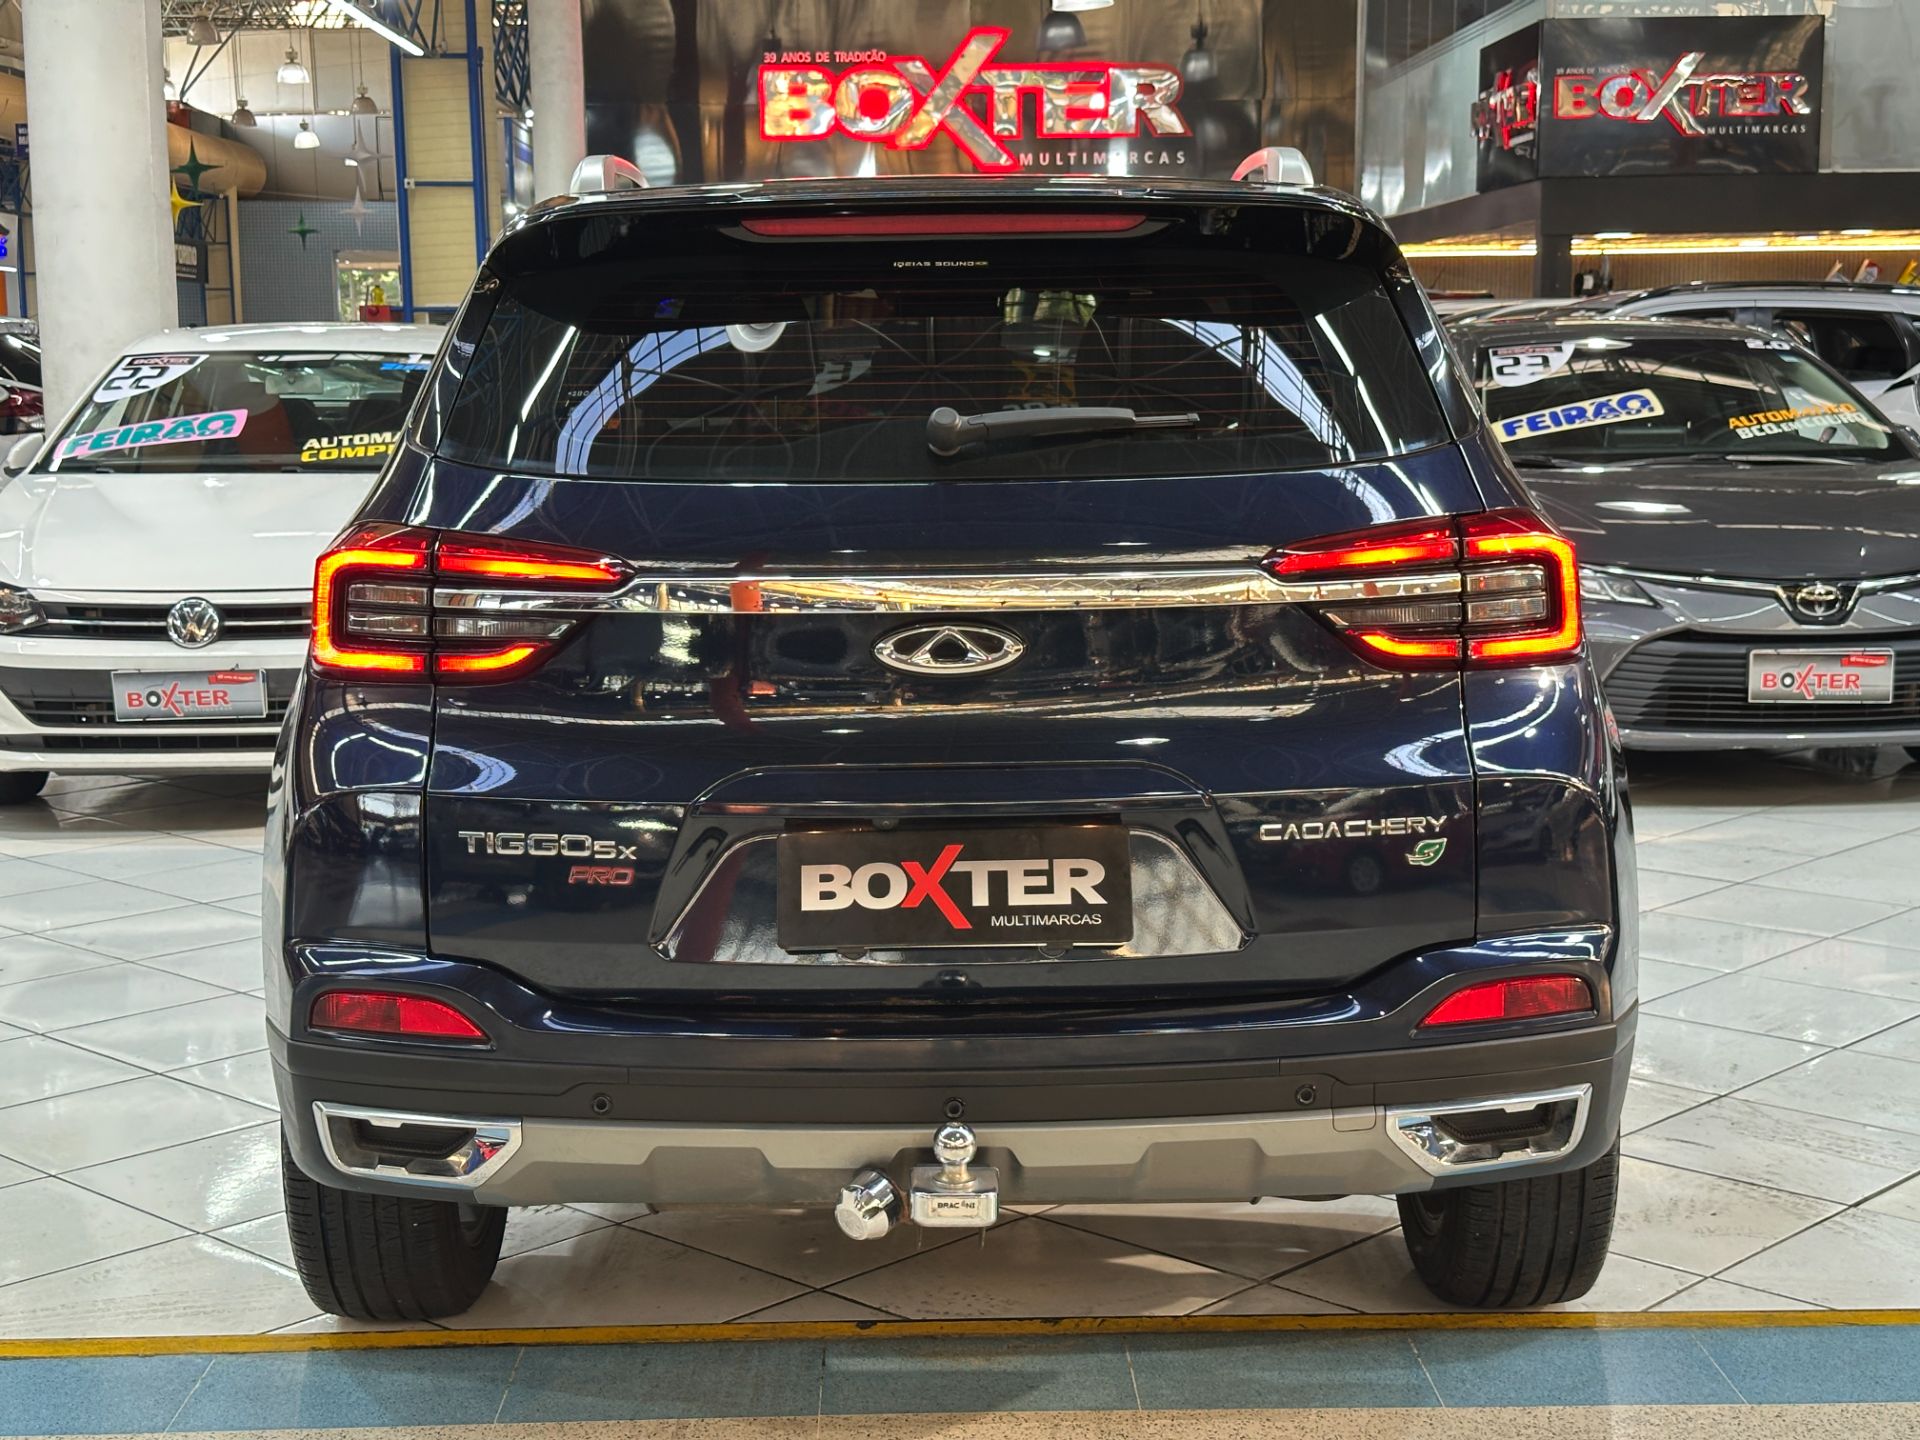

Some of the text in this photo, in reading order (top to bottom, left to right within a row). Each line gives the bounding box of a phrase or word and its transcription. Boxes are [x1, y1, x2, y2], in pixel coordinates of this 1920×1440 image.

[762, 48, 887, 63] 39 ANOS DE TRADIÇÃO
[758, 26, 1192, 171] BOXTER
[1554, 51, 1812, 136] BOXTER
[1706, 124, 1806, 135] MULTIMARCAS
[1019, 151, 1186, 166] MULTIMRCAS
[1744, 338, 1791, 350] 2.0
[1495, 354, 1551, 377] 23
[101, 366, 170, 391] 22
[1760, 663, 1861, 699] BOXTER
[126, 681, 231, 716] BOXTER
[568, 865, 635, 886] PRO
[800, 844, 1109, 929] BOXTER
[990, 913, 1102, 927] MULTIMARCAS
